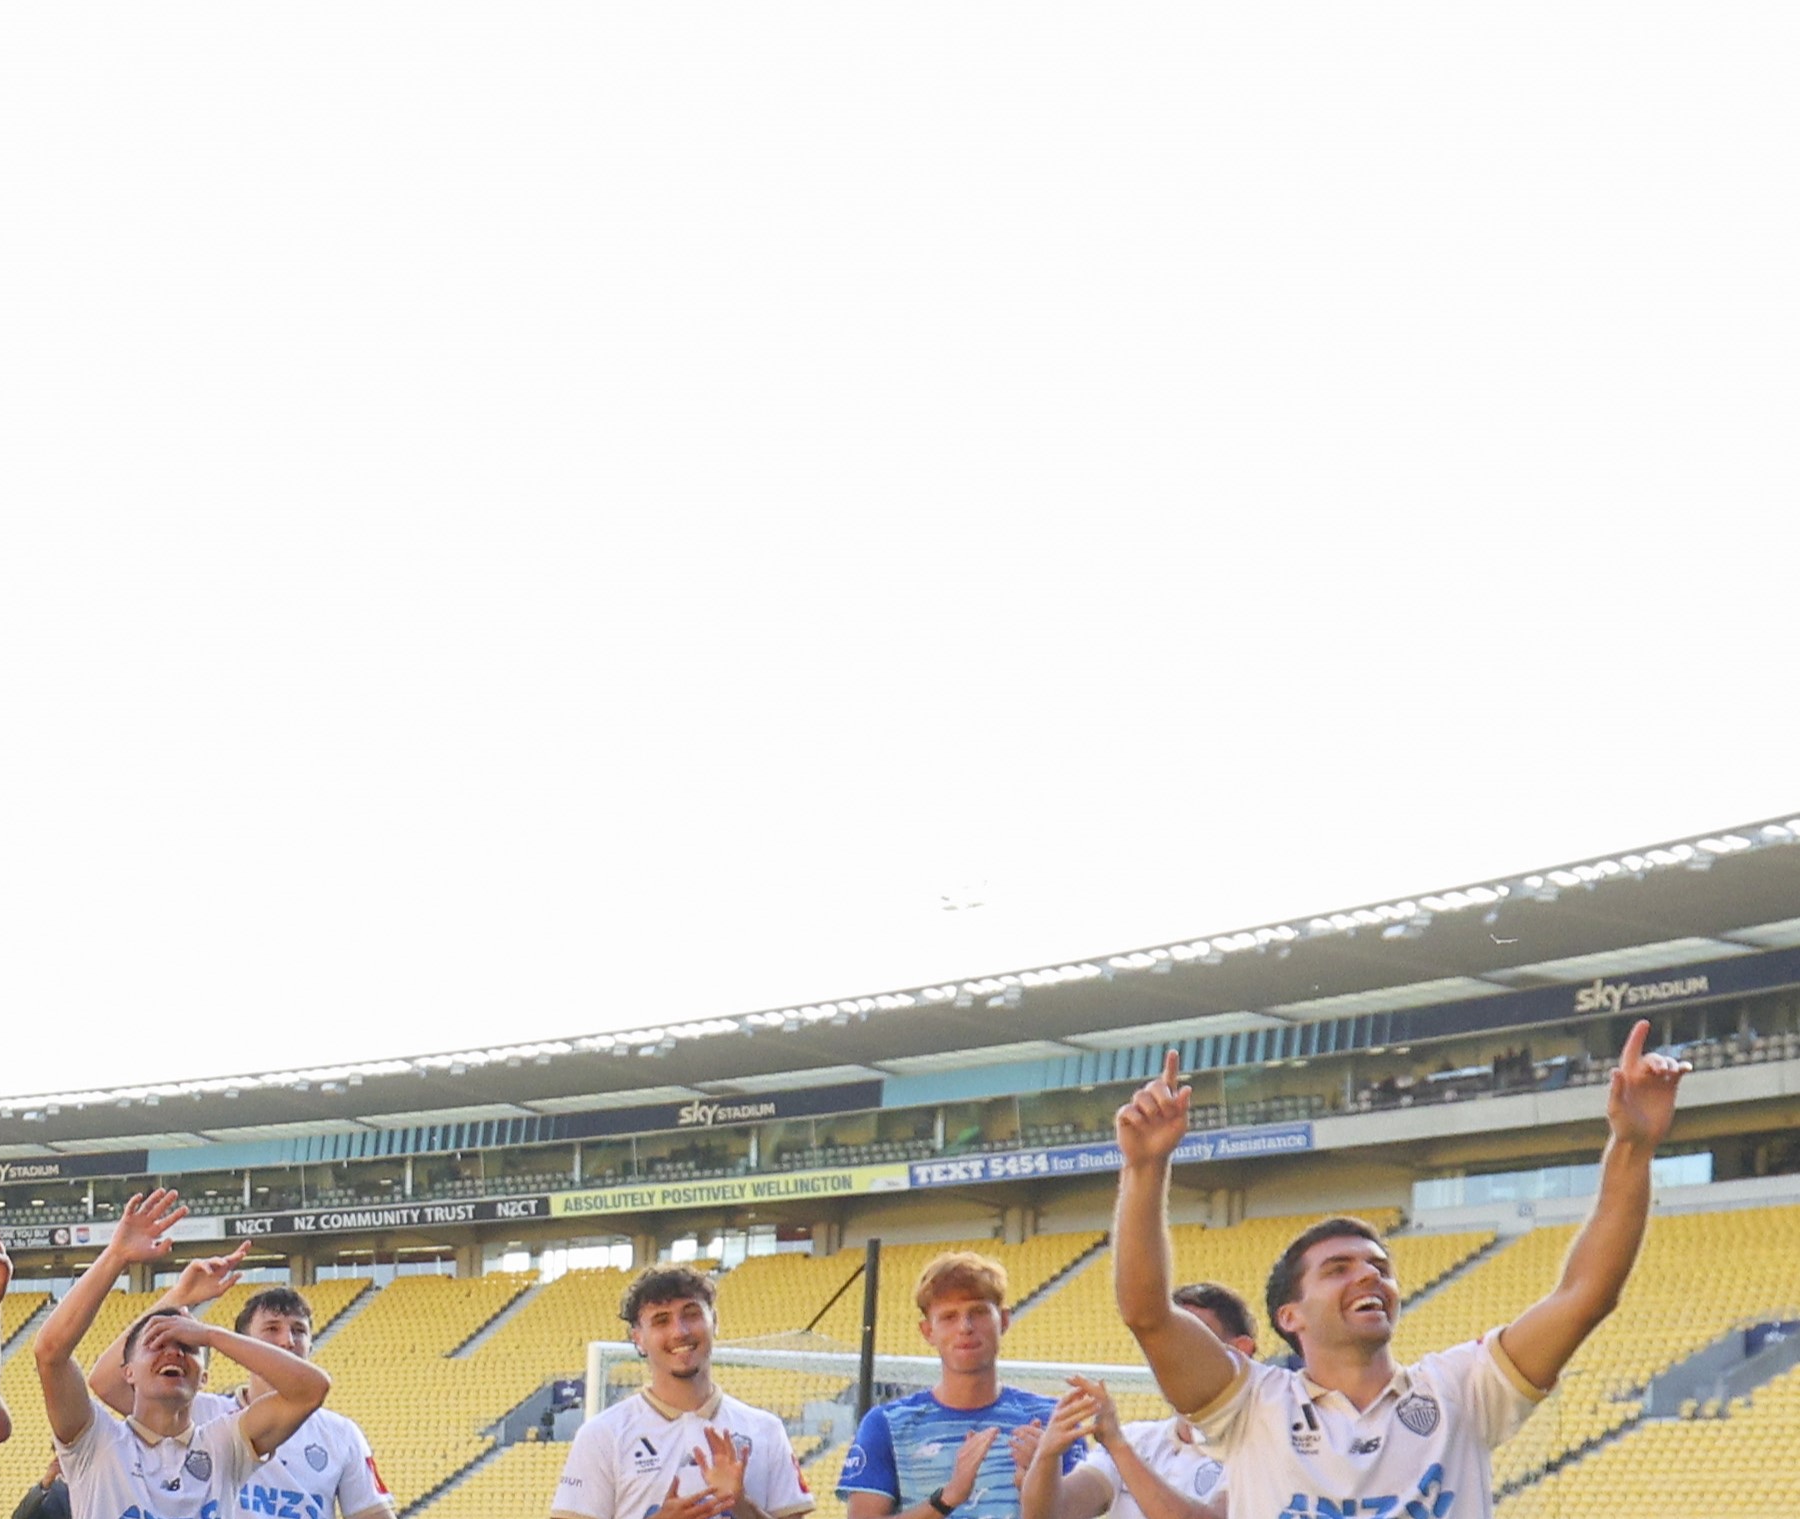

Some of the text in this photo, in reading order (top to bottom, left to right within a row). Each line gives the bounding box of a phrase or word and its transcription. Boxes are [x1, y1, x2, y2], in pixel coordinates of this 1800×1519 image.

[1574, 976, 1709, 1012] sky STADIUM
[679, 1100, 776, 1125] sky STADIUM
[9, 1164, 59, 1178] STADIUM
[914, 1160, 986, 1183] TEXT
[989, 1153, 1050, 1177] 5454
[1052, 1156, 1074, 1171] for
[1079, 1150, 1125, 1170] Stadi
[1215, 1131, 1308, 1154] Assistance
[563, 1174, 853, 1213] ABSOLUTELY POSITIVELY WELLINGTON
[236, 1200, 539, 1234] NZCT NZ COMMUNITY TRUST NZCT
